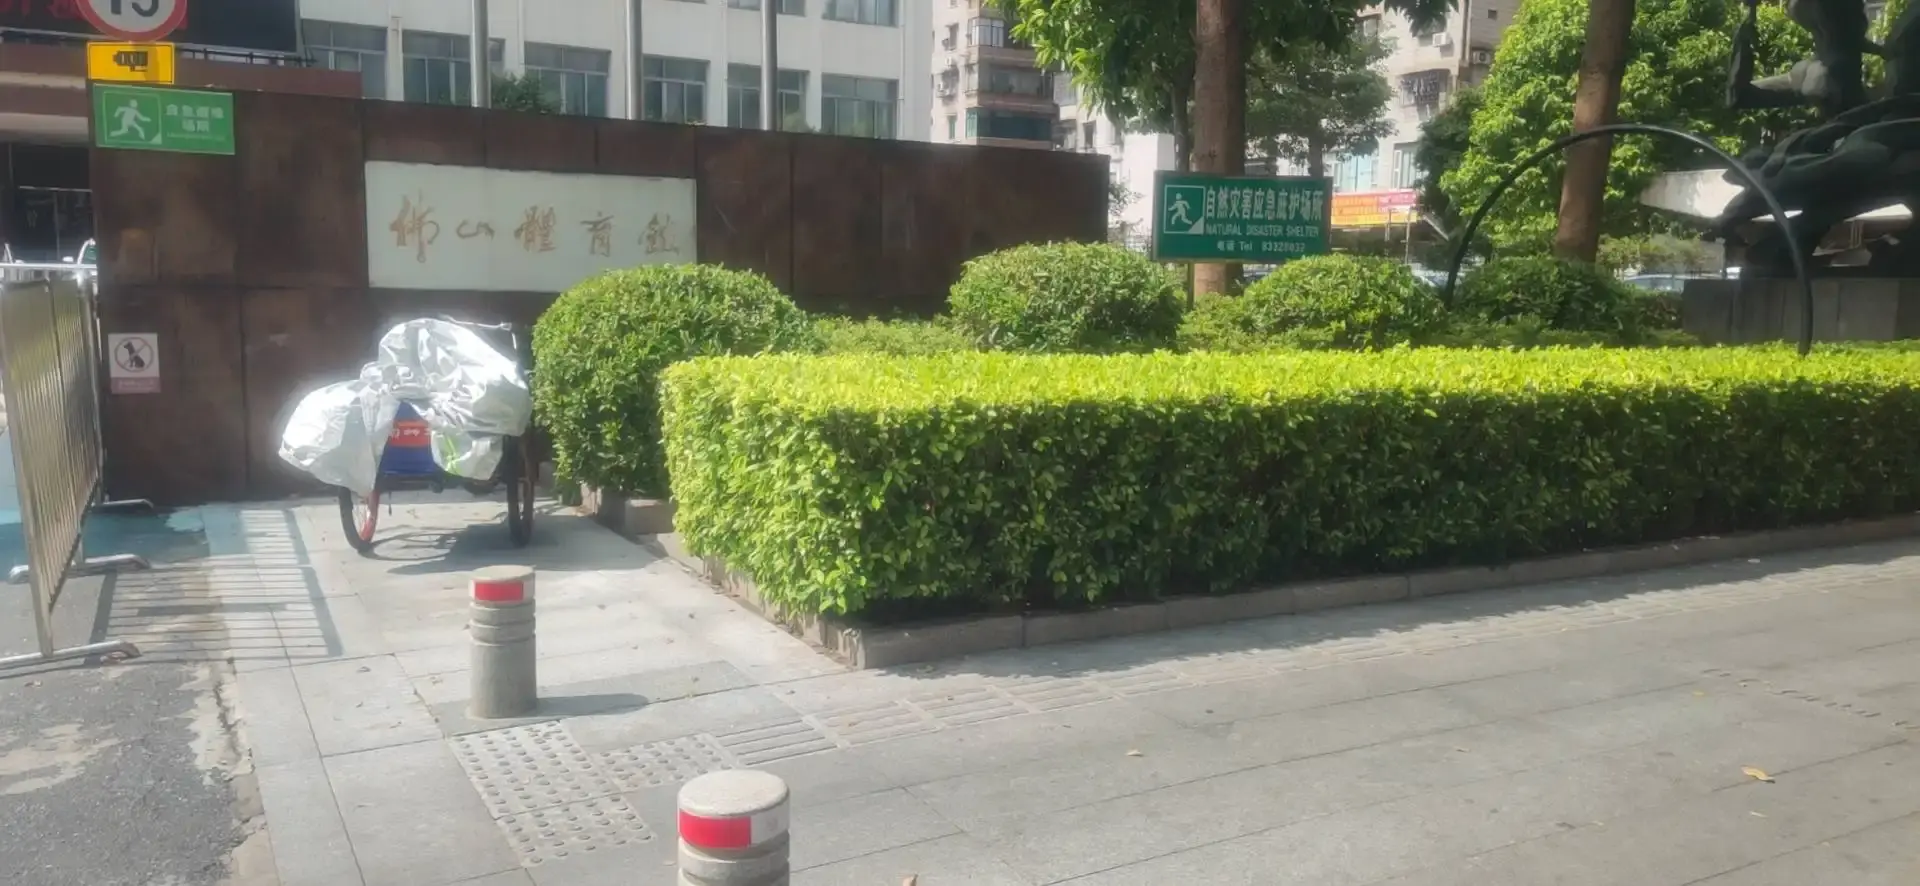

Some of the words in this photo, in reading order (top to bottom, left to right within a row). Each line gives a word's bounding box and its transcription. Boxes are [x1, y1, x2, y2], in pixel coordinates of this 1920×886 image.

[1206, 223, 1242, 236] NATURAL
[1246, 224, 1284, 237] DISASTER
[1286, 226, 1319, 238] SHELTER
